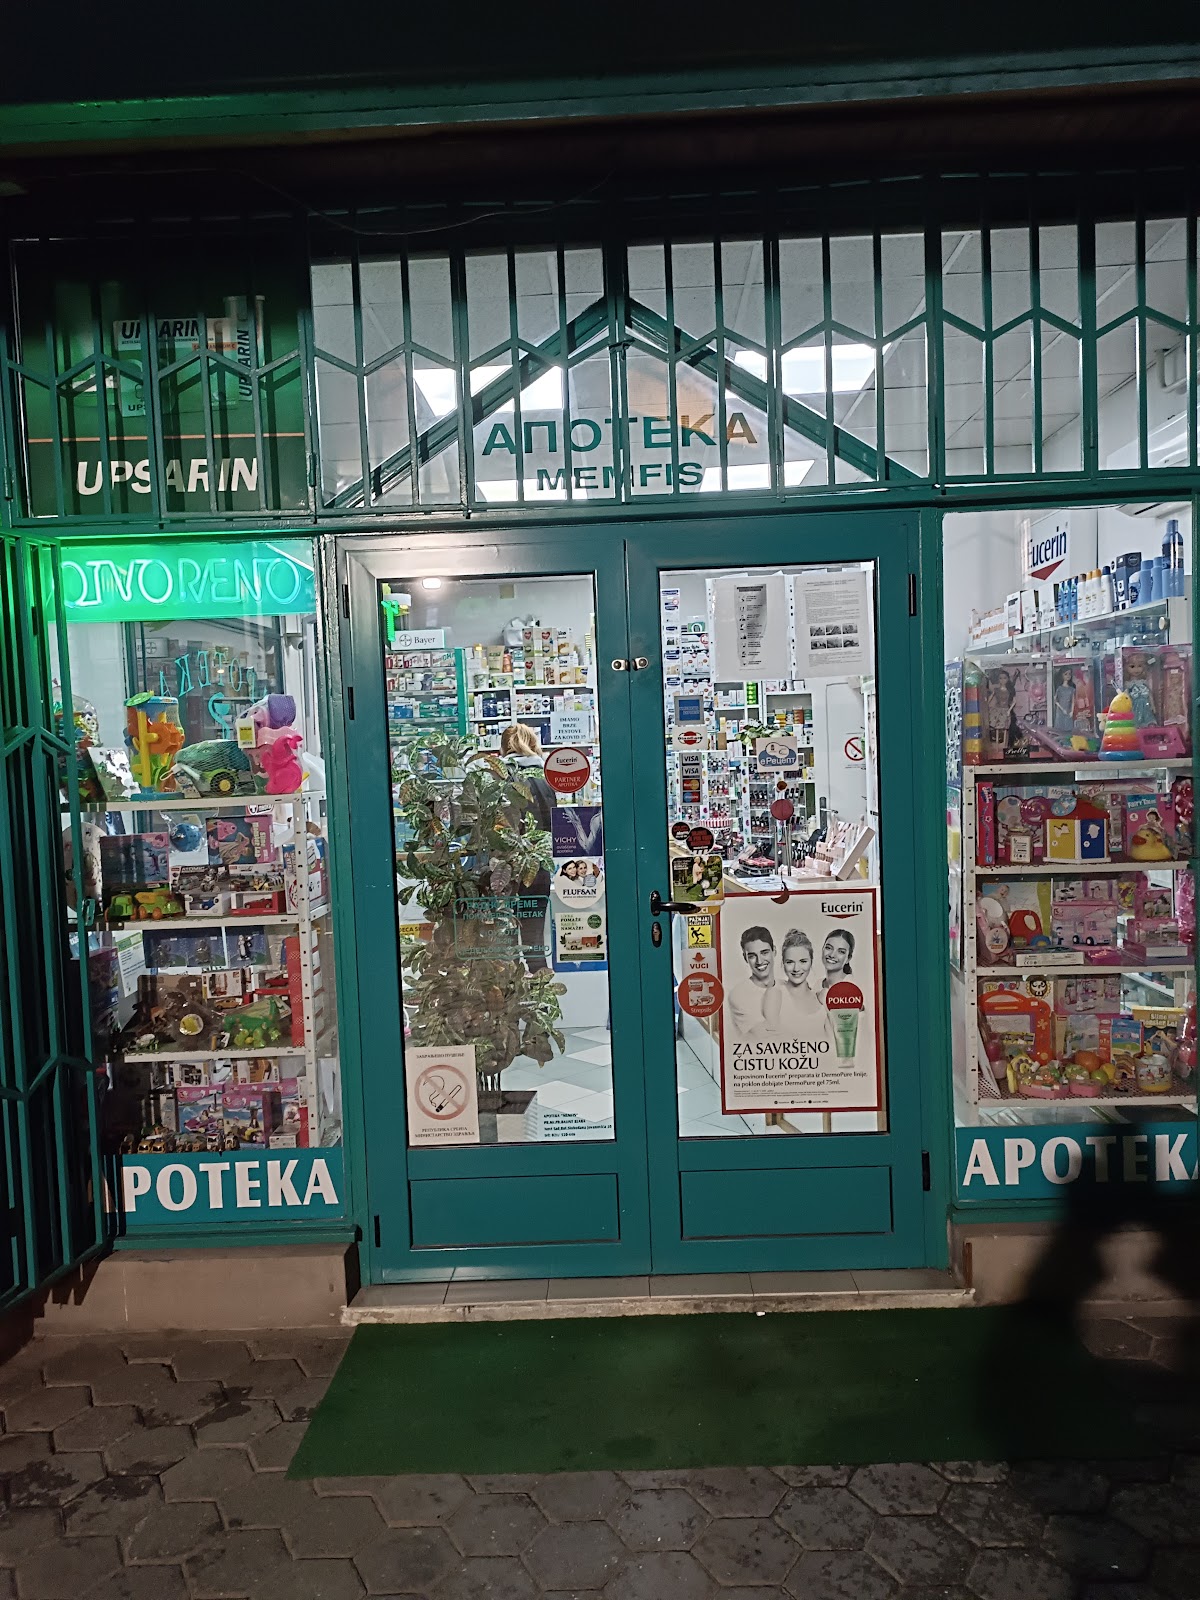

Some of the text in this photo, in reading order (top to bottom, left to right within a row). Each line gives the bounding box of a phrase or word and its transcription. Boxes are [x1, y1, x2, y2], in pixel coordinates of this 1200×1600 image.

[77, 457, 258, 496] UPSARIN
[414, 636, 436, 645] Bayer
[563, 888, 597, 896] FLUFSAN
[821, 901, 863, 913] Eucerin
[732, 1038, 830, 1055] ZA SAVRŠENO
[733, 1054, 819, 1071] ČISTU KOŽU
[761, 1080, 783, 1088] dobijate
[816, 1079, 825, 1087] gel
[962, 1133, 1198, 1186] APOTEK
[105, 1158, 339, 1214] POTEKA
